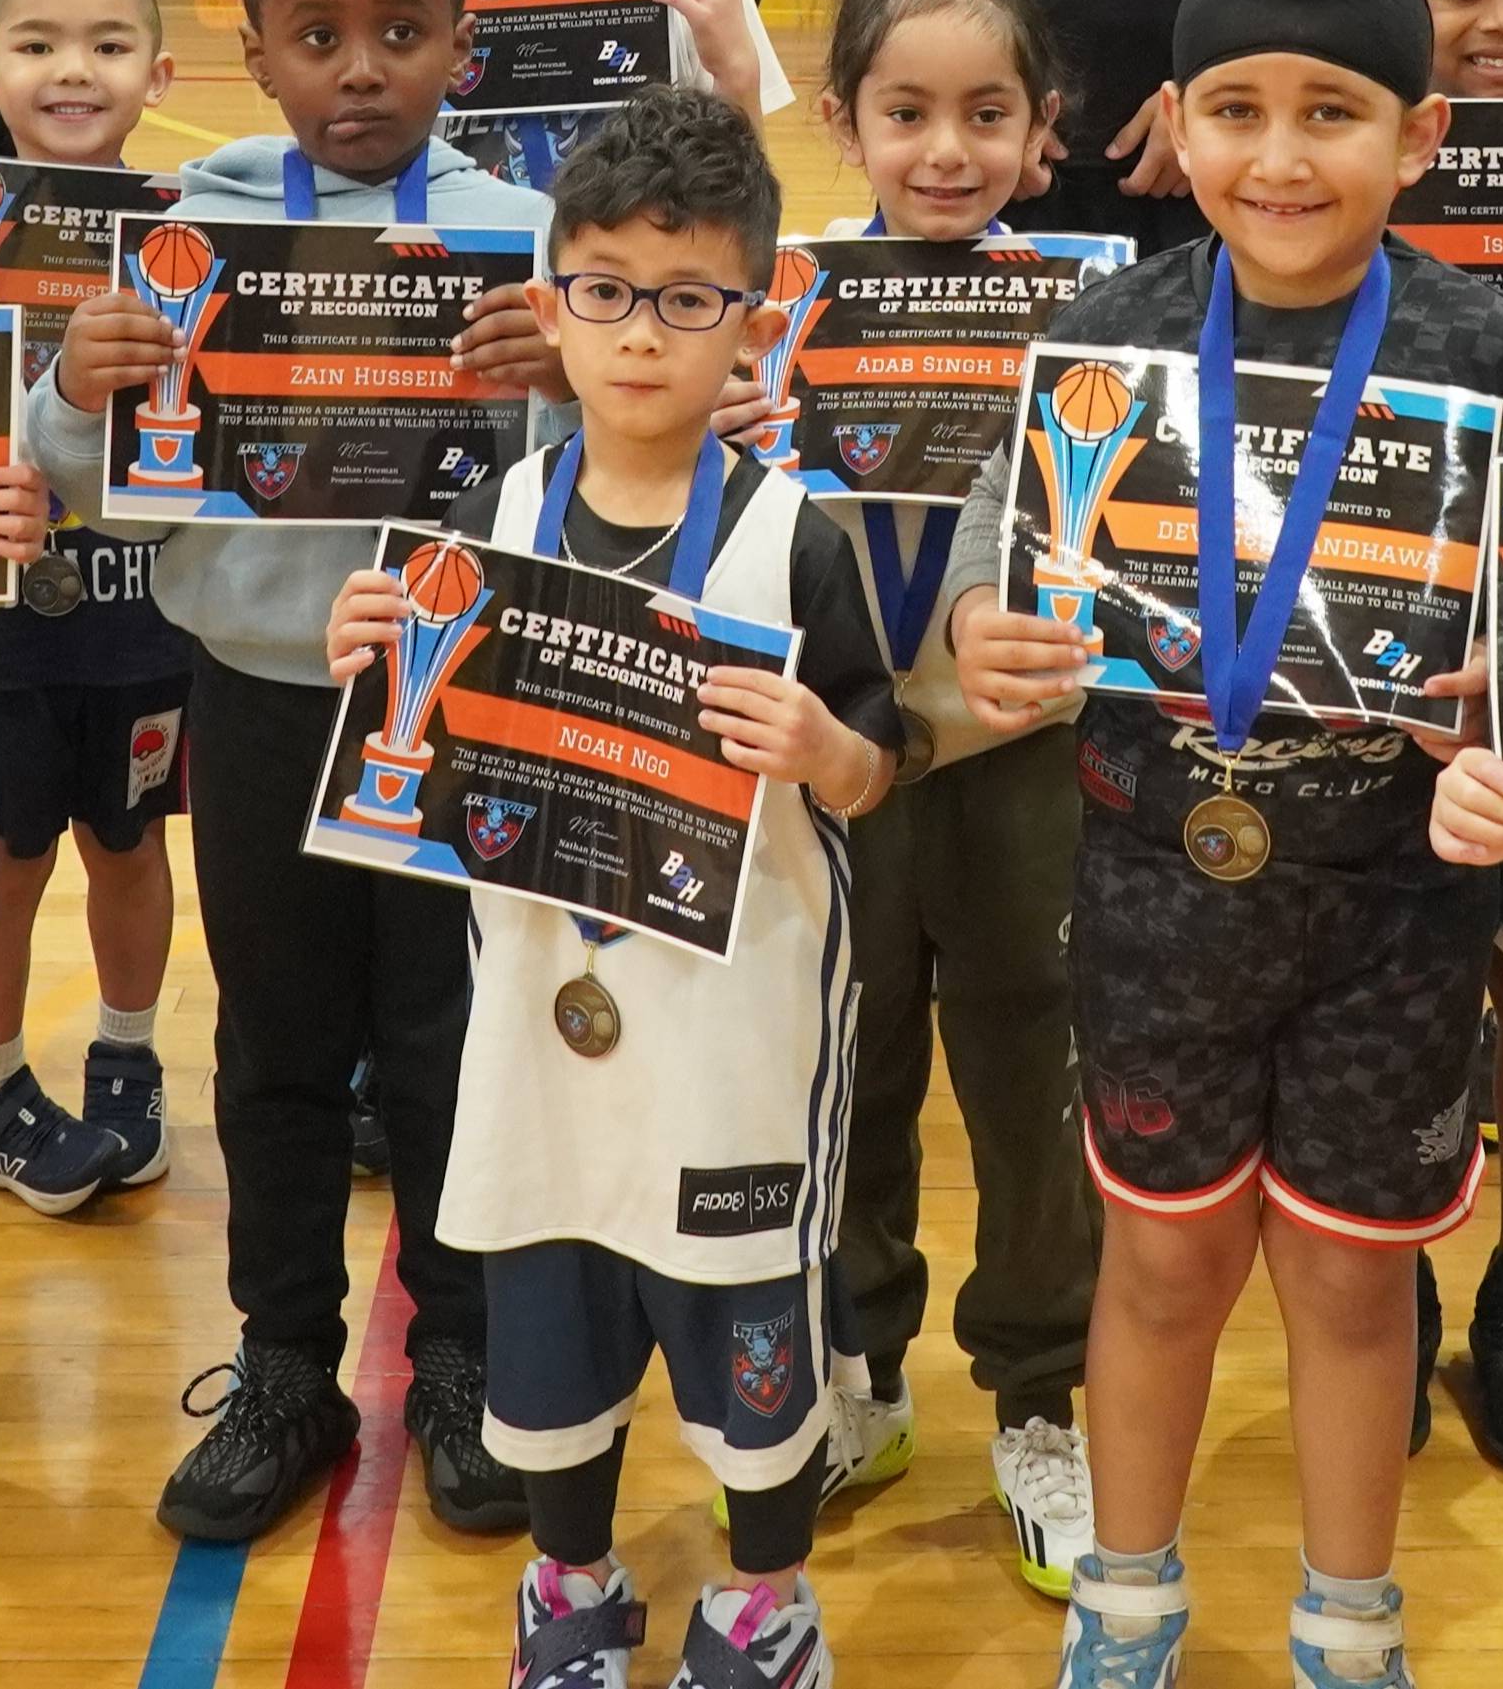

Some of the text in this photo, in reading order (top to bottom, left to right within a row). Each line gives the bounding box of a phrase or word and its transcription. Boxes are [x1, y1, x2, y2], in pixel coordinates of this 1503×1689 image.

[1458, 174, 1481, 186] OF
[59, 229, 79, 241] OF
[37, 279, 109, 301] SEBAST
[237, 270, 482, 302] CERTIFICATE
[839, 277, 1075, 300] CERTIFICATE
[280, 300, 438, 318] OF RECOGNITION
[879, 301, 1032, 314] OF RECOGNITION
[290, 364, 453, 388] ZAIN HUSSEIN
[855, 355, 913, 373] ADAB
[922, 355, 989, 375] SINGH
[438, 446, 489, 487] B2H
[1313, 533, 1441, 572] ANDHAWA
[498, 605, 710, 690] CERTIFICAT
[1360, 627, 1424, 680] B2H
[539, 647, 685, 705] OF RECOGNITION
[515, 679, 692, 742] THIS CERTIFICATE IS PRESENTED TO
[557, 723, 672, 779] NOAH NGO
[659, 849, 705, 903] B2H
[755, 1182, 790, 1211] 5XS
